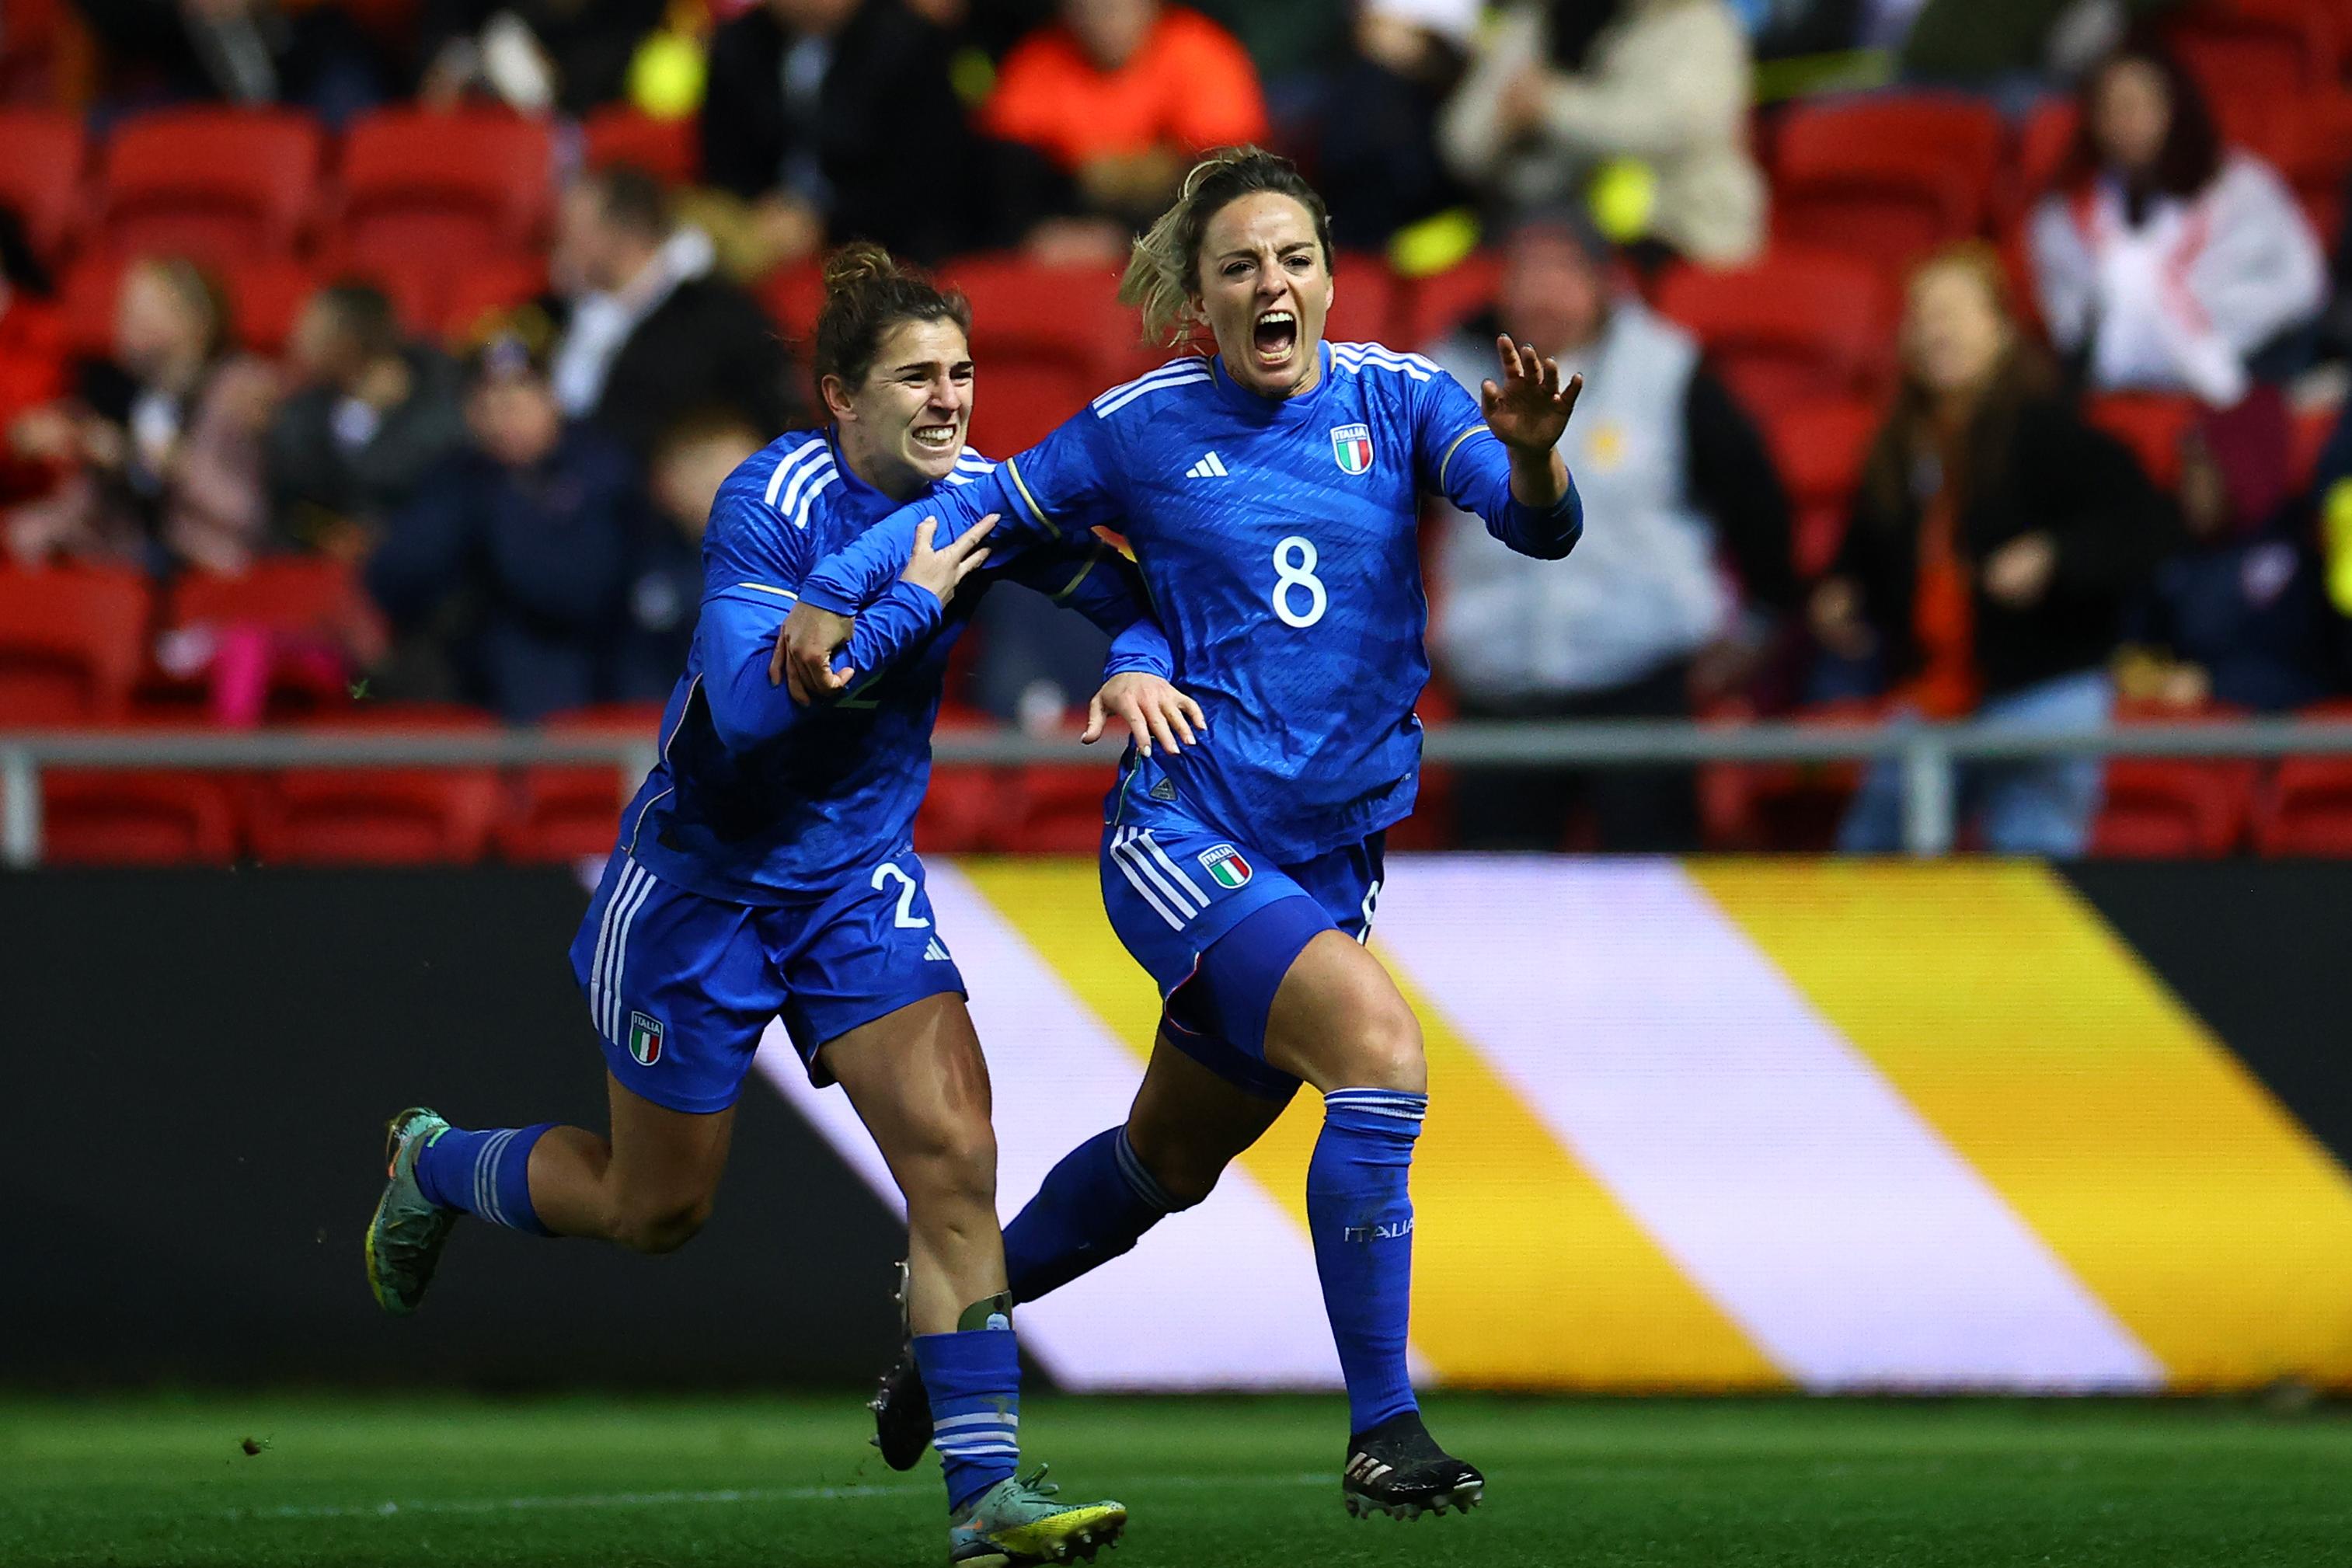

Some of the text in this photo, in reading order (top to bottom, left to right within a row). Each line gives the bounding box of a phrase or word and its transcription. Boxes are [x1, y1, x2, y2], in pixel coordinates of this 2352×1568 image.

[1334, 427, 1368, 440] ITALIA
[1273, 535, 1327, 629] 8
[1202, 847, 1234, 865] ITALIA
[871, 862, 930, 929] 2
[633, 1015, 660, 1034] ITALIA
